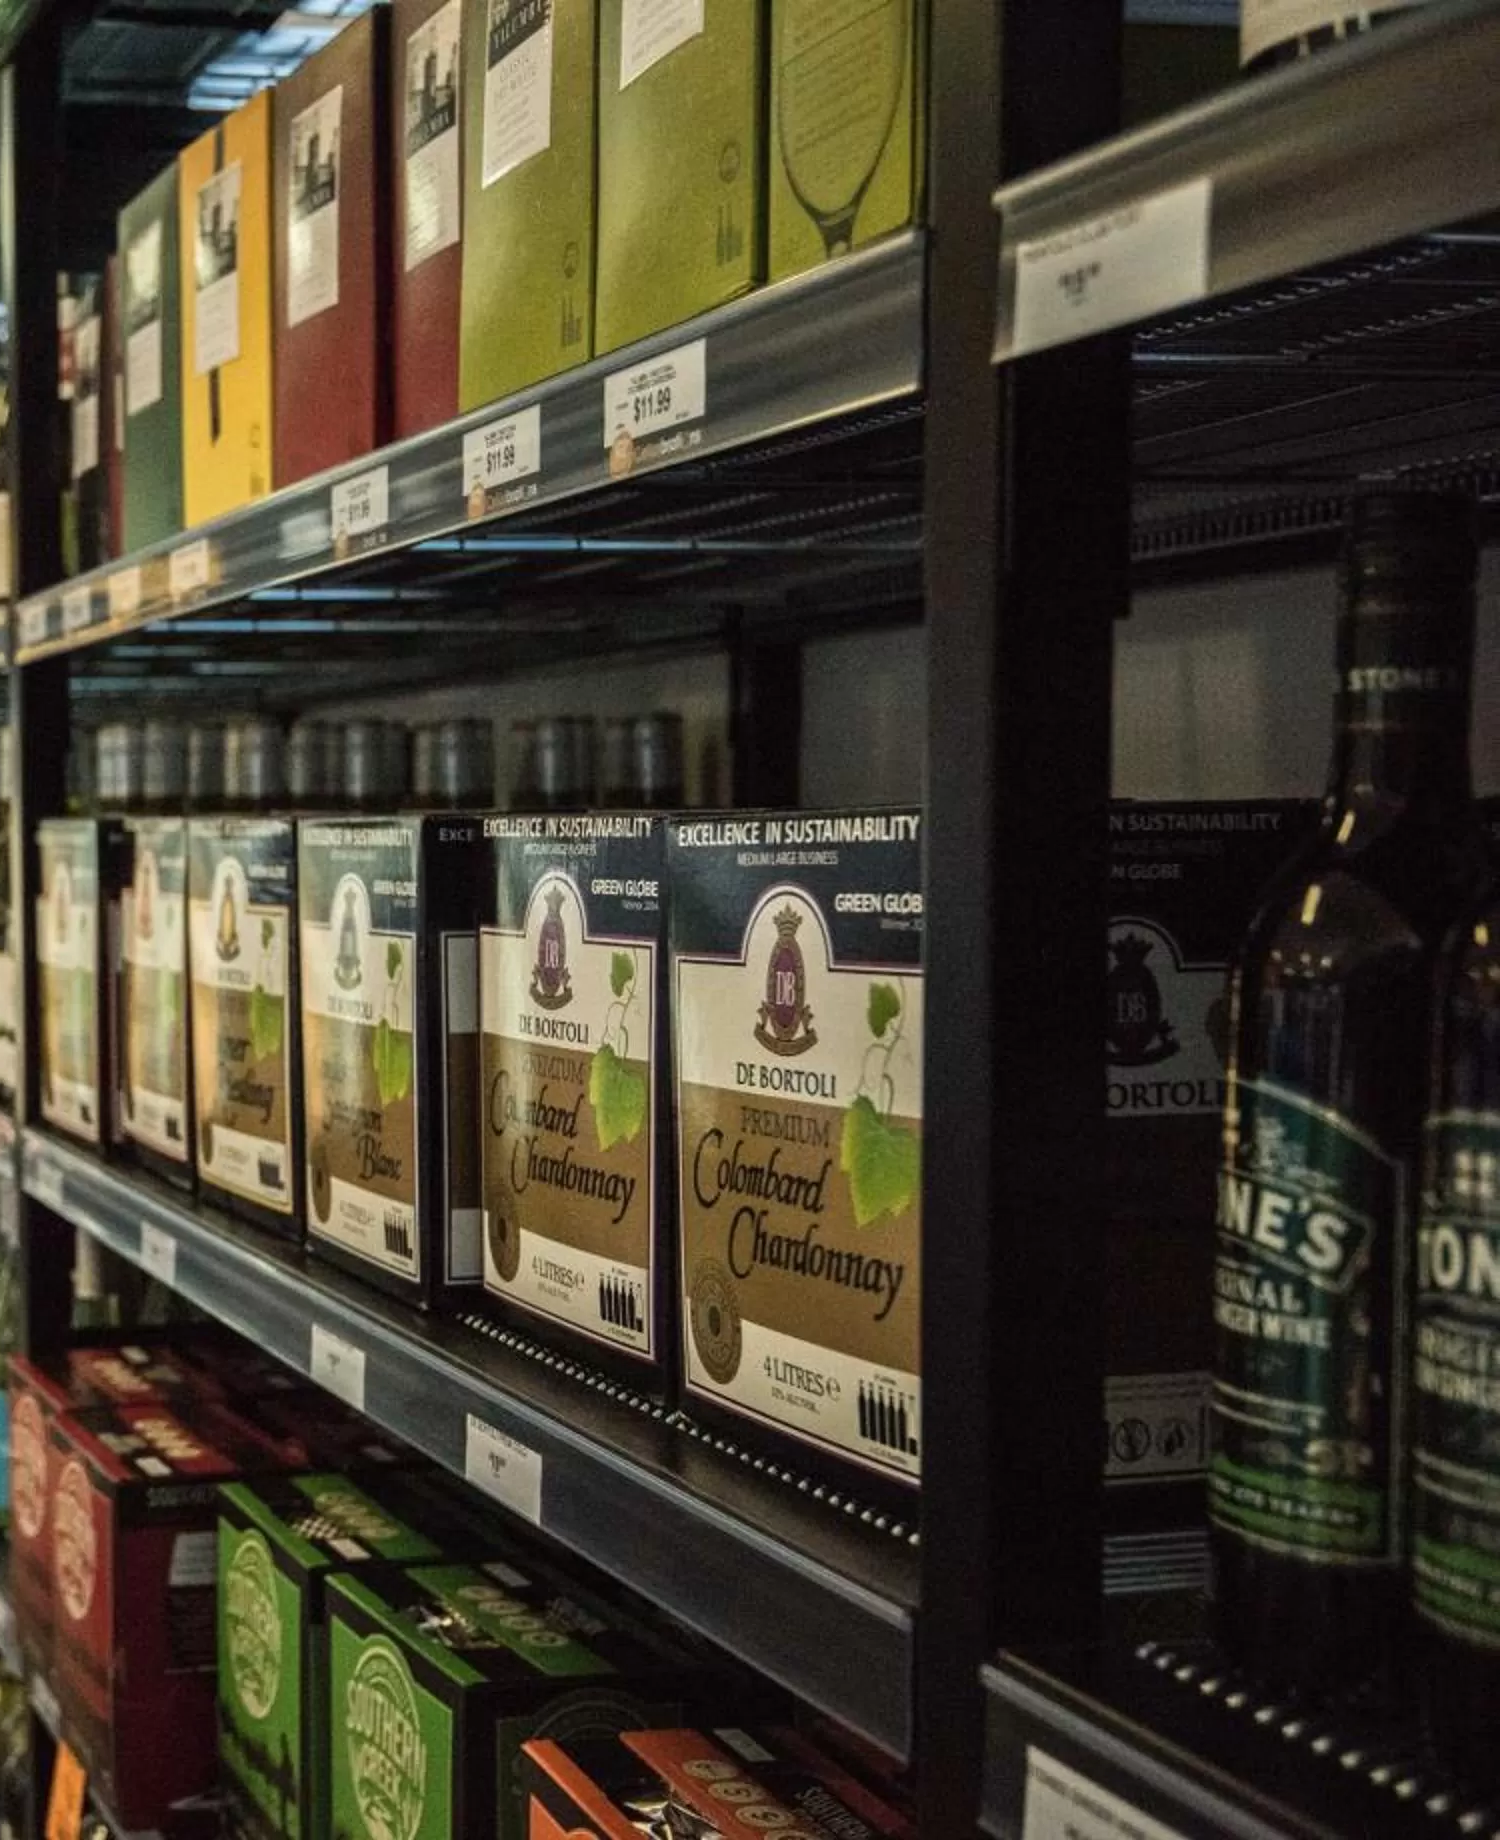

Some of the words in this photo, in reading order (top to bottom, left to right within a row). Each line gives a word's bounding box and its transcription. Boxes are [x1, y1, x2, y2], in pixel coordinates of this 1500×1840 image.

[633, 386, 671, 424] $11.99
[486, 443, 515, 475] $11.99
[483, 818, 543, 837] EXCELLENCE
[545, 818, 559, 837] IN
[560, 817, 653, 838] SUSTAINABILITY
[678, 822, 760, 847] EXCELLENCE
[765, 821, 782, 845] IN
[784, 816, 920, 844] SUSTAINABILITY
[591, 879, 624, 896] GREEN
[834, 893, 882, 913] GREEN
[883, 893, 923, 914] GLOB
[518, 1013, 533, 1035] DE
[534, 1016, 589, 1045] BORTOLI
[736, 1062, 756, 1087] DE
[759, 1065, 837, 1099] BORTOLI
[1105, 1080, 1223, 1110] ORTOLI
[740, 1105, 831, 1148] PREMIUM
[511, 1136, 636, 1225] Chardonnay
[693, 1128, 832, 1213] Colombard
[728, 1206, 905, 1320] Chardonnay
[763, 1355, 772, 1378] 4
[774, 1359, 824, 1397] LITRES
